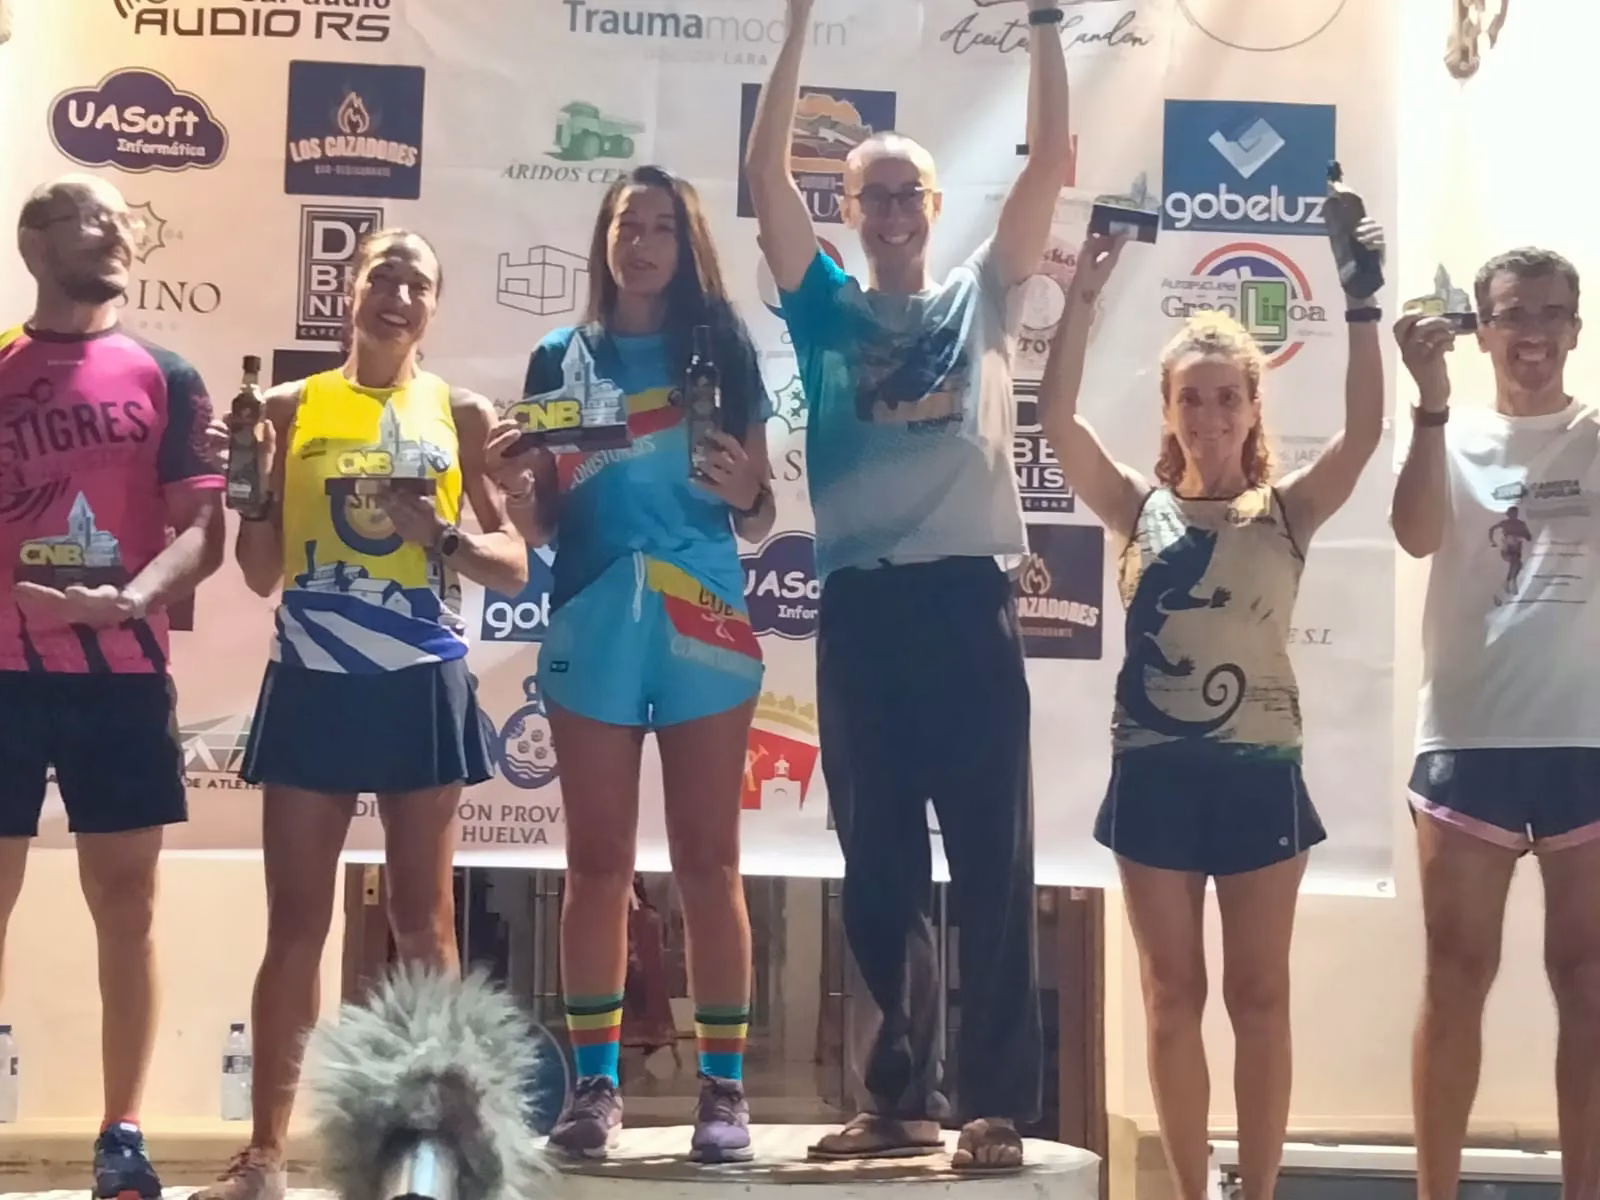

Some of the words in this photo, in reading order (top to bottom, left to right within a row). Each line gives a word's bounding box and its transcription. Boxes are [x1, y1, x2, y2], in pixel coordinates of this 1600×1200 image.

[134, 8, 301, 37] AUDIO
[315, 12, 391, 42] RS
[68, 99, 200, 137] UASoft
[117, 138, 206, 156] Informática
[289, 138, 322, 162] LOS
[324, 136, 418, 167] CAZADORES
[1165, 183, 1327, 228] gobeluz
[113, 279, 222, 314] INO
[1018, 338, 1051, 353] TO
[4, 401, 149, 461] TIGRES
[1015, 596, 1099, 627] AZADORES
[461, 825, 549, 845] HUELVA
